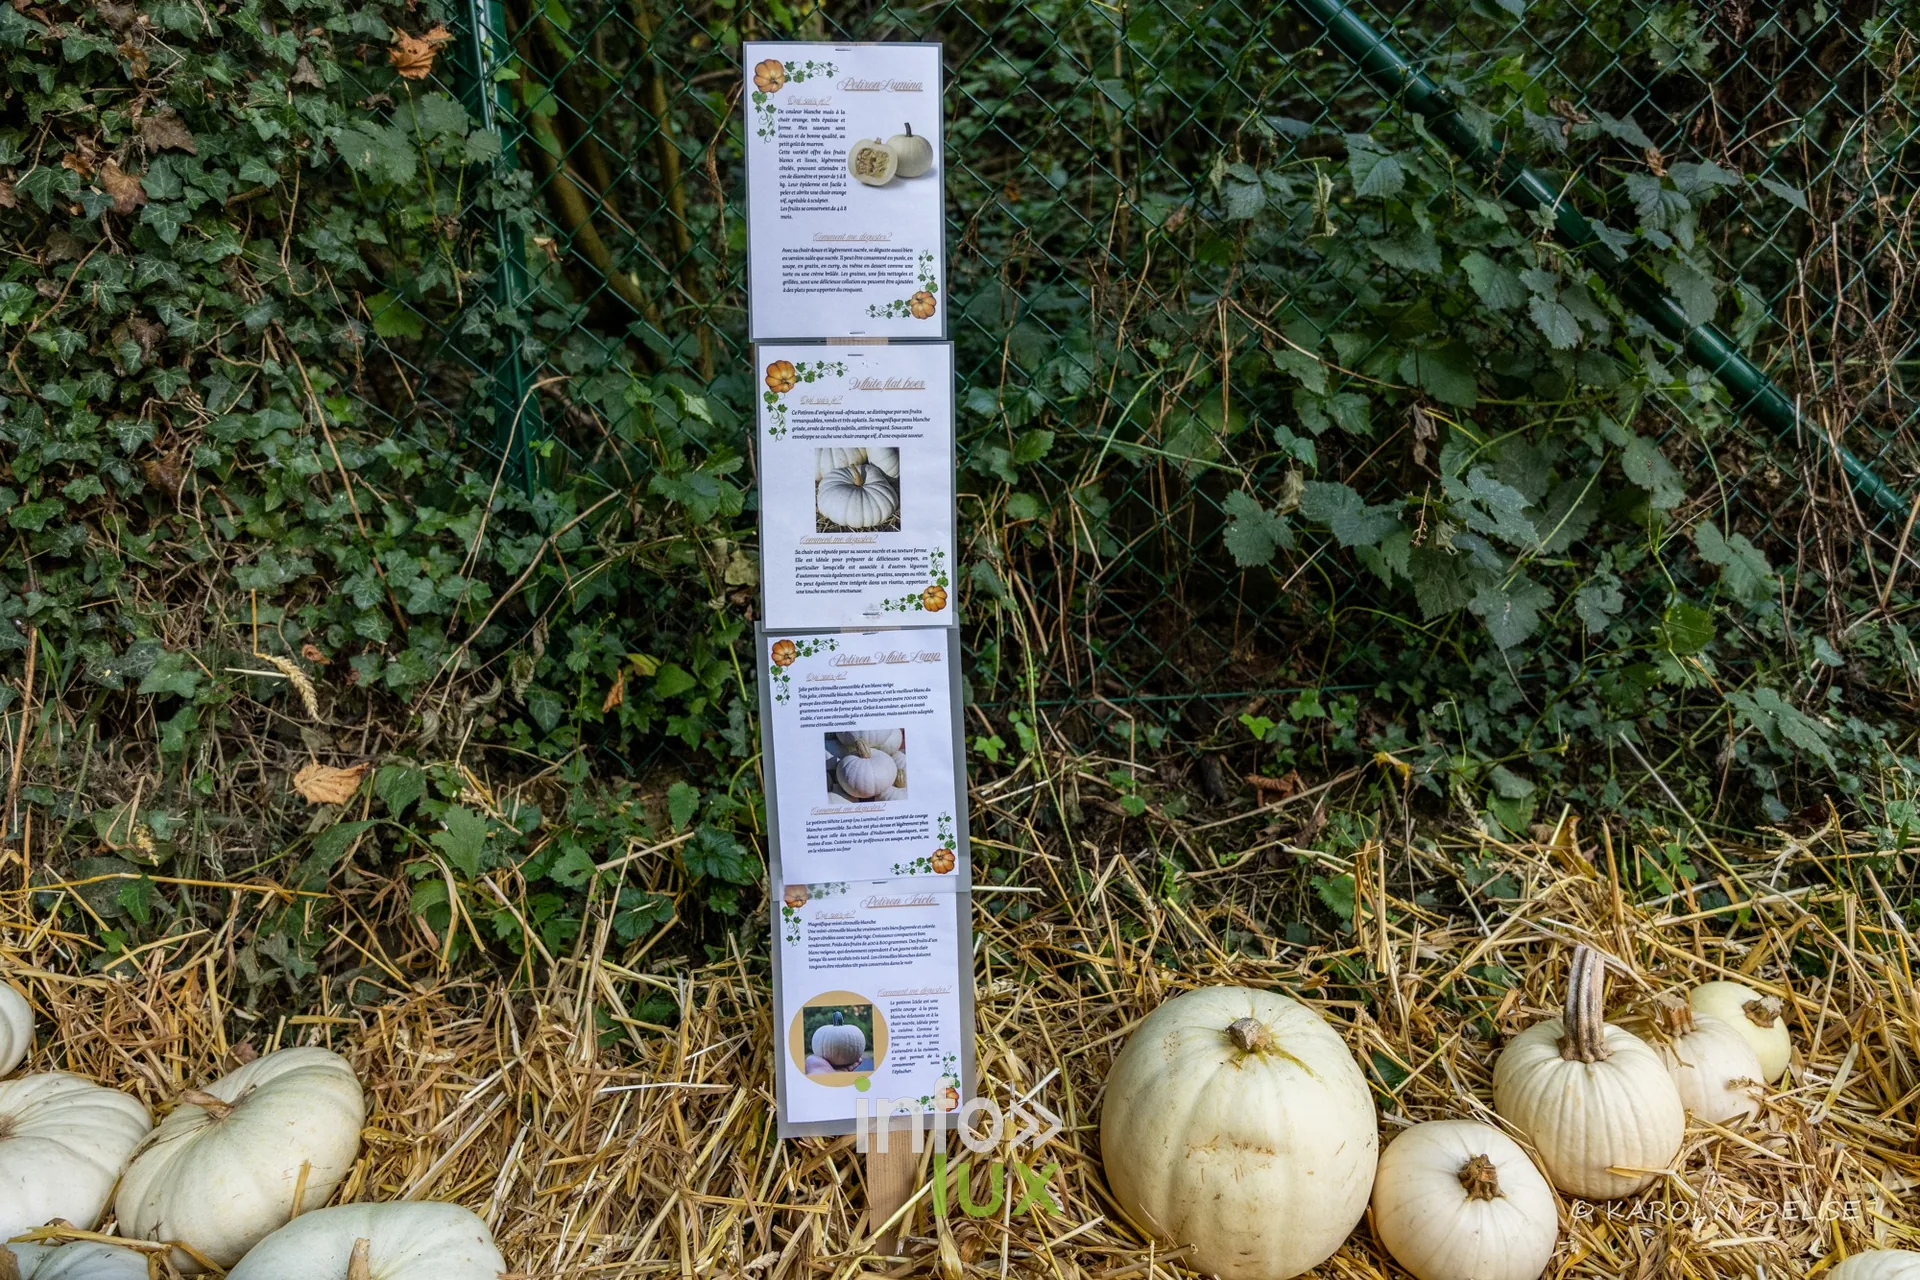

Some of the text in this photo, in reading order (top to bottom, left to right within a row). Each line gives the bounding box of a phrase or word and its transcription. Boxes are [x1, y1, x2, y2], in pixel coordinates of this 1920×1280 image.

[837, 78, 923, 92] Potiron Lumina
[849, 376, 925, 392] White flat boer
[829, 650, 942, 667] Potiron White Lamp
[860, 893, 938, 908] Potiron Icicle
